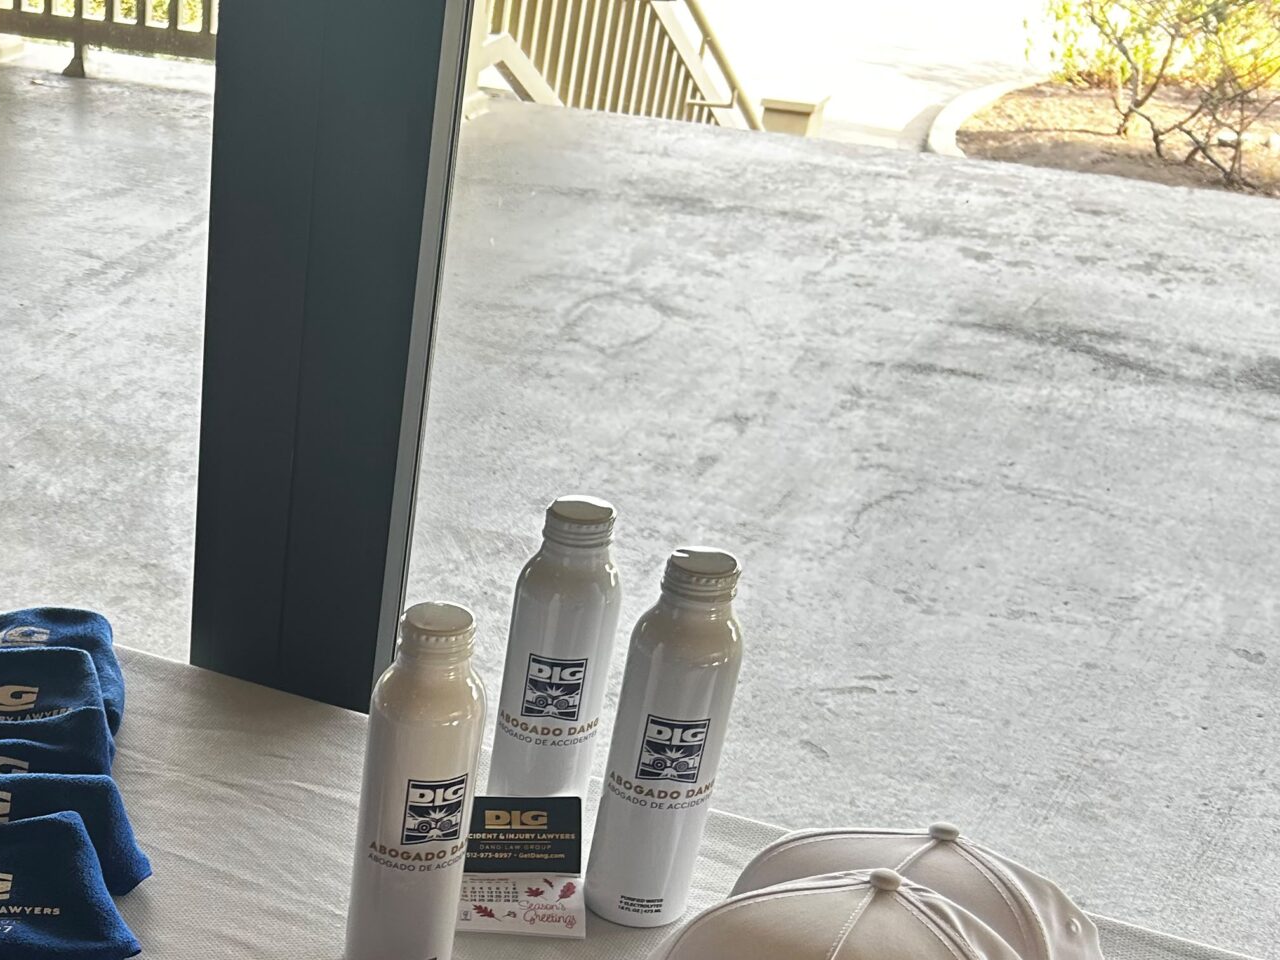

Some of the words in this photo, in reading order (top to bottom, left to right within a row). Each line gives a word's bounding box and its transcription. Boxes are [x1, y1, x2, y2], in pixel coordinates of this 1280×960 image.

[528, 662, 584, 684] DLG
[500, 710, 563, 737] ABOGADO
[535, 738, 548, 746] DE
[647, 723, 706, 746] DLG
[409, 785, 464, 806] DLG
[609, 771, 681, 800] ABOGADO
[650, 801, 665, 809] DE
[484, 810, 548, 829] DLG
[369, 841, 446, 861] ABOGADO
[368, 853, 415, 871] ABOGADO
[418, 864, 432, 872] DE
[523, 909, 577, 929] Greetings
